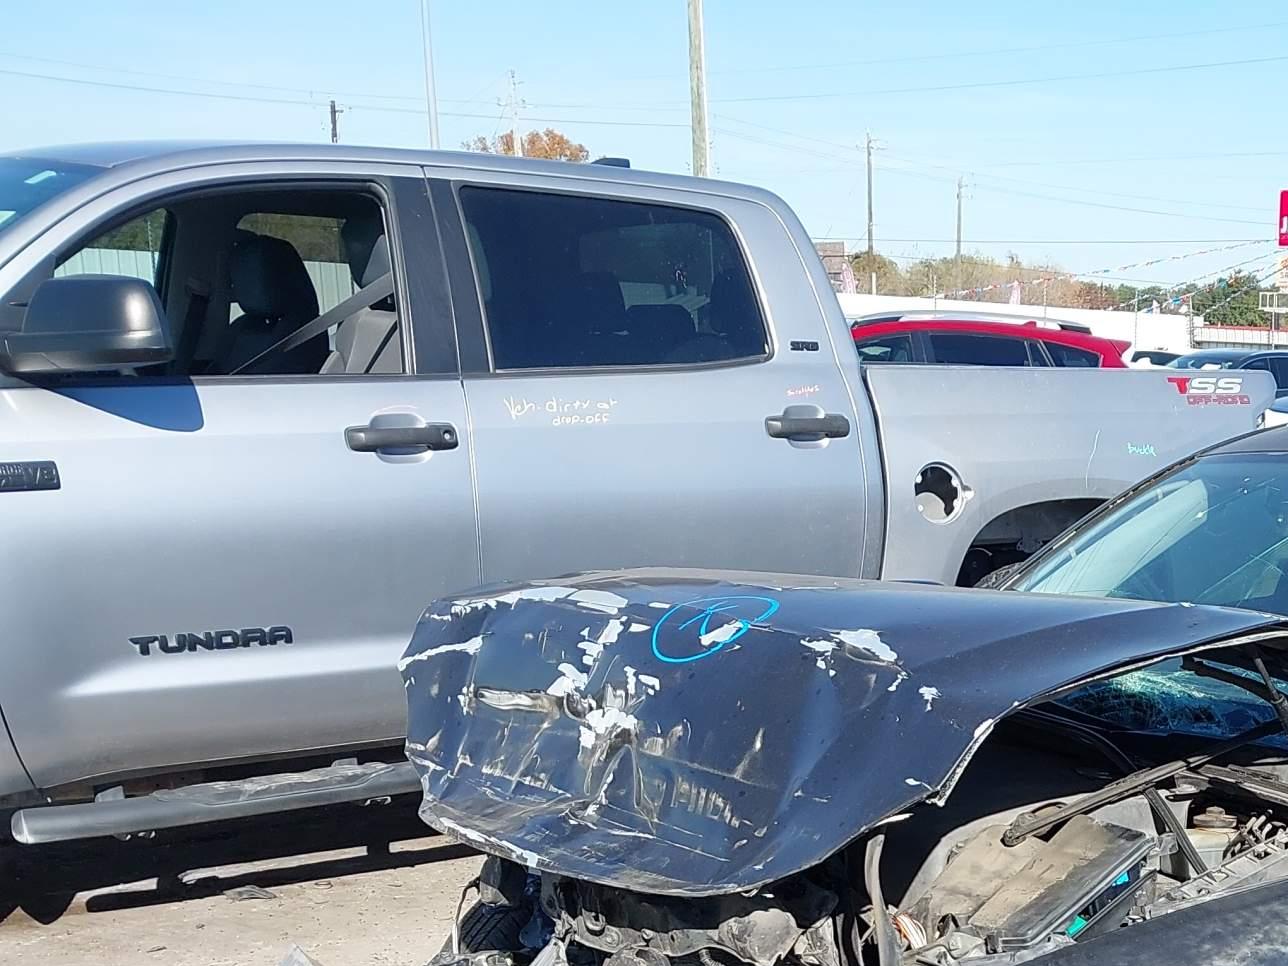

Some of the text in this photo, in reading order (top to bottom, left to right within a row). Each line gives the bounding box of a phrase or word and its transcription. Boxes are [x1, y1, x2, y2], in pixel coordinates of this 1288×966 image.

[1167, 377, 1243, 395] TSS
[1187, 395, 1251, 405] OFF-ROAD
[128, 626, 293, 656] TUNDRA
